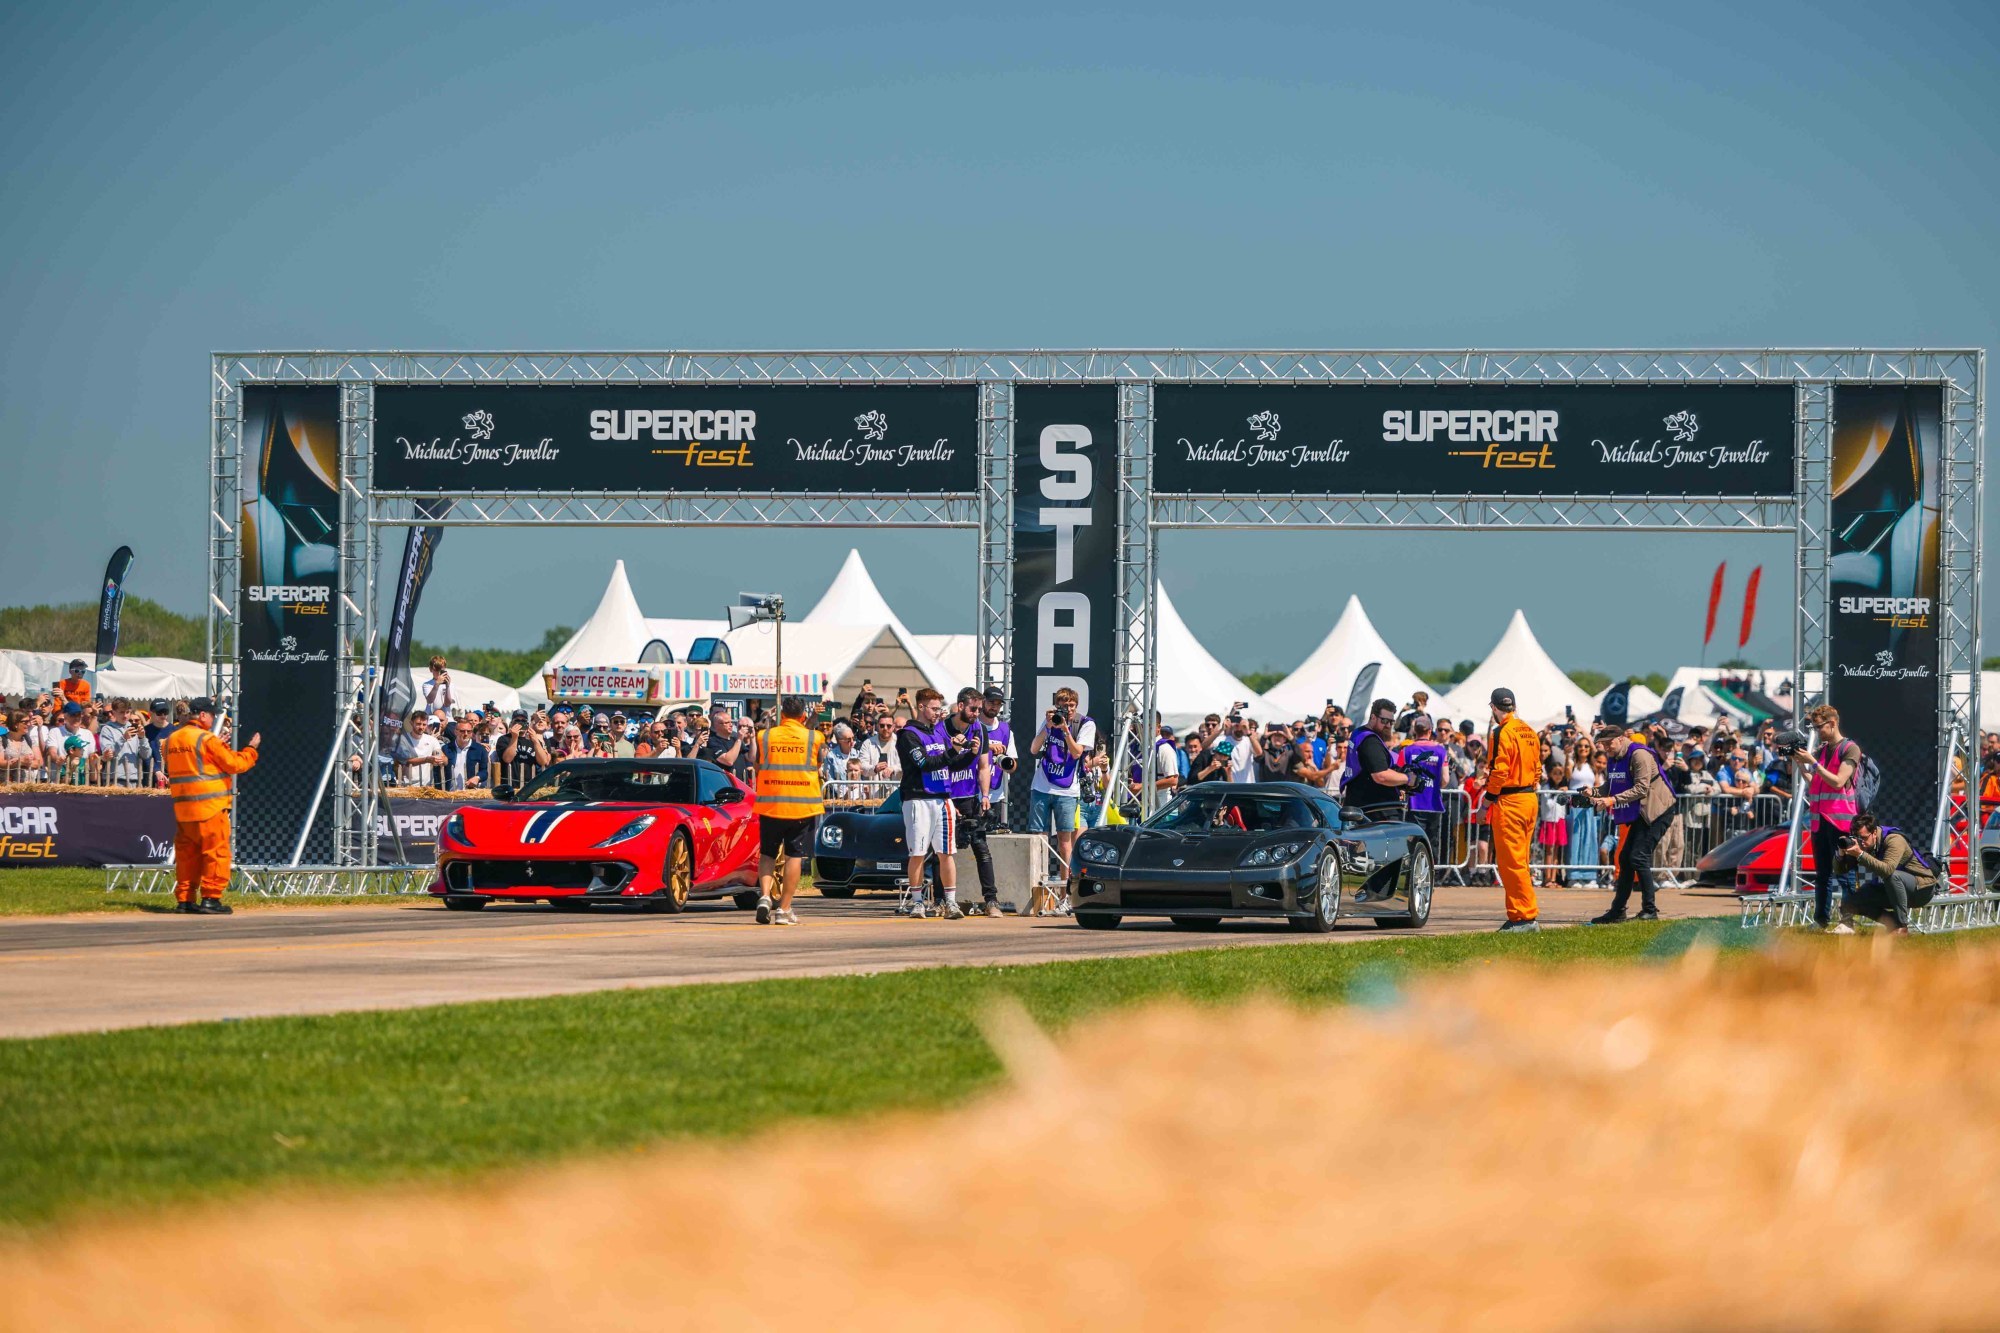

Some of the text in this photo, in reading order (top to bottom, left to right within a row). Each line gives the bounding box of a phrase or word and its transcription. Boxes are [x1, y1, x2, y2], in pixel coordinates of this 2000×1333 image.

[590, 409, 756, 441] SUPERCAR
[1382, 409, 1559, 442] SUPERCAR
[396, 437, 560, 466] Michael Jones Jeweller
[668, 442, 754, 467] fest
[787, 438, 955, 467] Michael Jones Jeweller
[1177, 438, 1350, 468] Michael Jones Jeweller
[1464, 443, 1556, 469] fest
[1591, 439, 1770, 469] Michael Jones Jeweller
[248, 585, 330, 602] SUPERCAR
[286, 602, 329, 615] fest
[1839, 597, 1930, 614] SUPERCAR
[1881, 614, 1929, 628] fest
[247, 648, 330, 664] Michael Jones Jeweller
[1838, 663, 1930, 680] Michael Jones Jeweller
[561, 675, 645, 689] SOFT ICE CREAM
[728, 678, 746, 689] SOFT
[747, 678, 759, 689] ICE
[770, 745, 805, 754] EVENTS
[0, 836, 59, 858] fest
